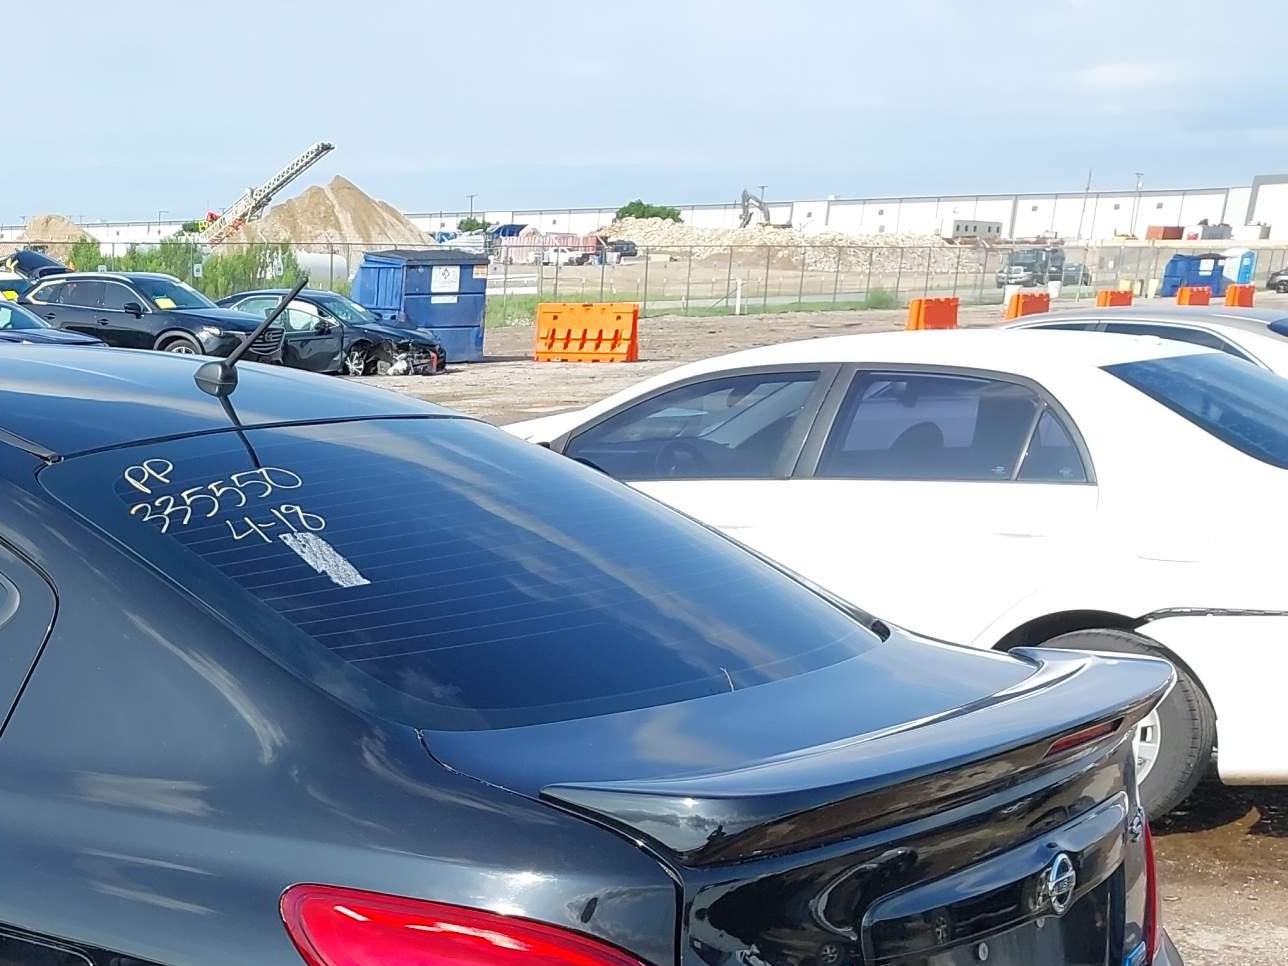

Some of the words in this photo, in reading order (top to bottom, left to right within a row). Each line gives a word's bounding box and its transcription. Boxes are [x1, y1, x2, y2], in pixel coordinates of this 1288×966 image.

[124, 458, 174, 494] PP
[130, 467, 303, 534] 335550
[225, 504, 326, 543] 4-18
